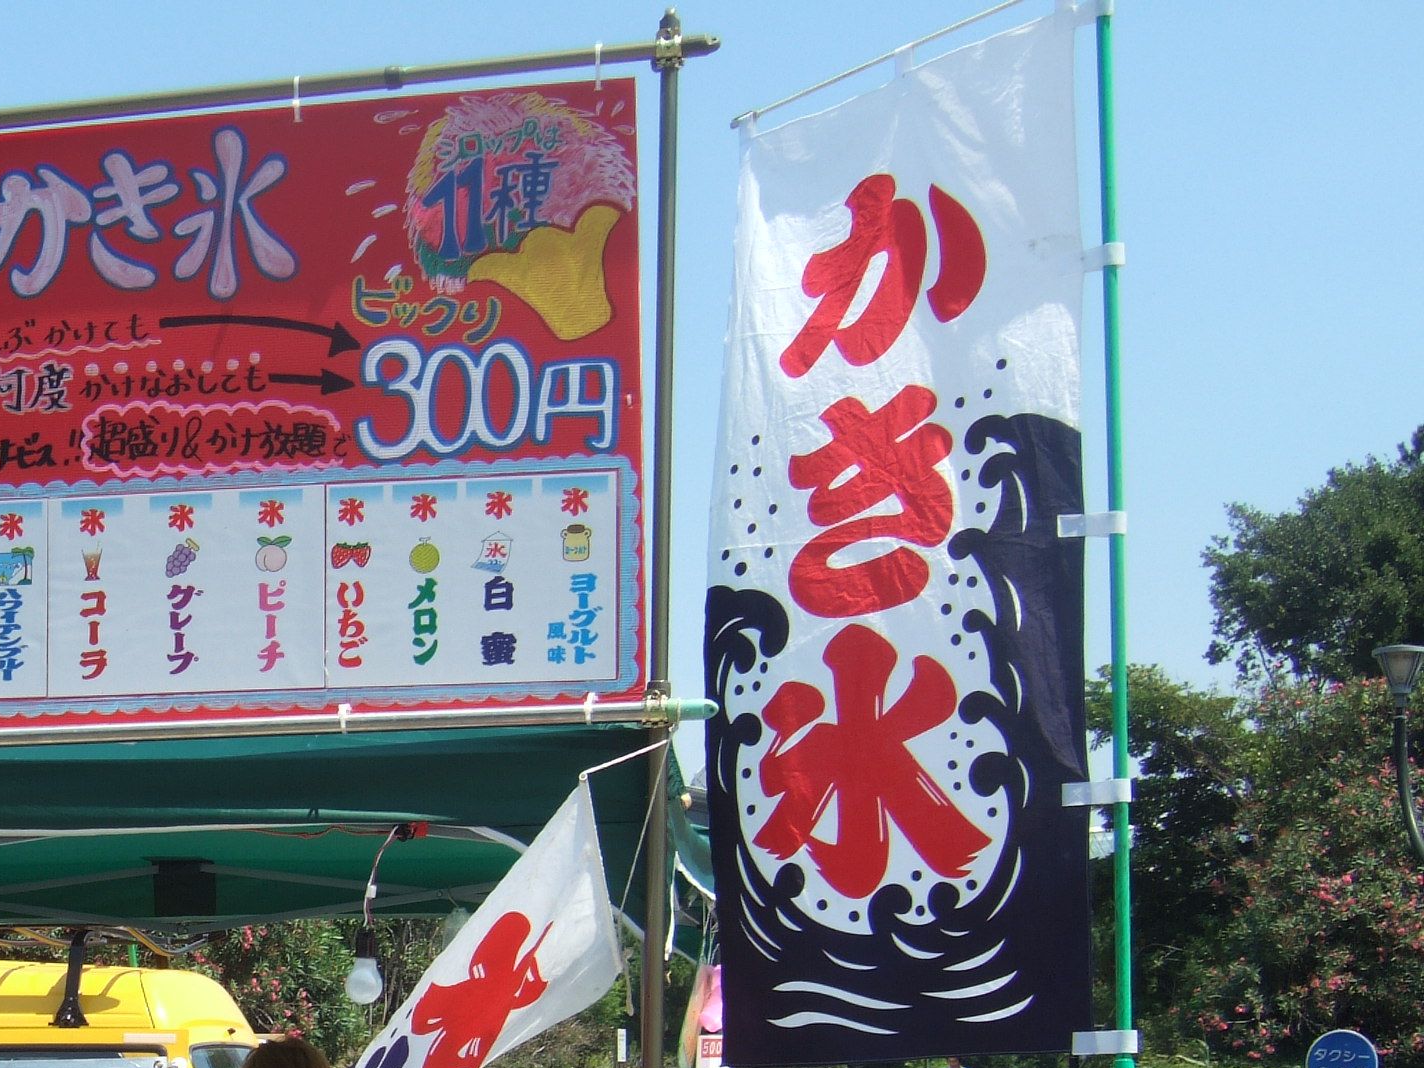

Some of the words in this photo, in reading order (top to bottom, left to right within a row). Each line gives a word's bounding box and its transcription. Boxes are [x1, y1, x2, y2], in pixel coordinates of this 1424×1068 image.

[422, 151, 560, 261] 11種
[351, 275, 502, 343] ビックリ
[355, 336, 622, 463] 300円
[79, 508, 106, 537] 氷
[168, 503, 195, 533] 氷
[257, 499, 285, 528] 氷
[338, 497, 365, 526] 氷
[409, 493, 438, 523] 氷
[485, 490, 514, 520] 氷
[561, 487, 590, 517] 氷
[753, 172, 992, 900] かき氷
[79, 590, 108, 681] コーラ
[166, 584, 205, 677] グレープ
[257, 579, 287, 673] ピーチ
[336, 580, 370, 669] いちご
[408, 577, 439, 667] メロン
[547, 621, 567, 665] 風味
[567, 572, 604, 665] ヨーグルト
[1314, 1049, 1370, 1062] タクシー
